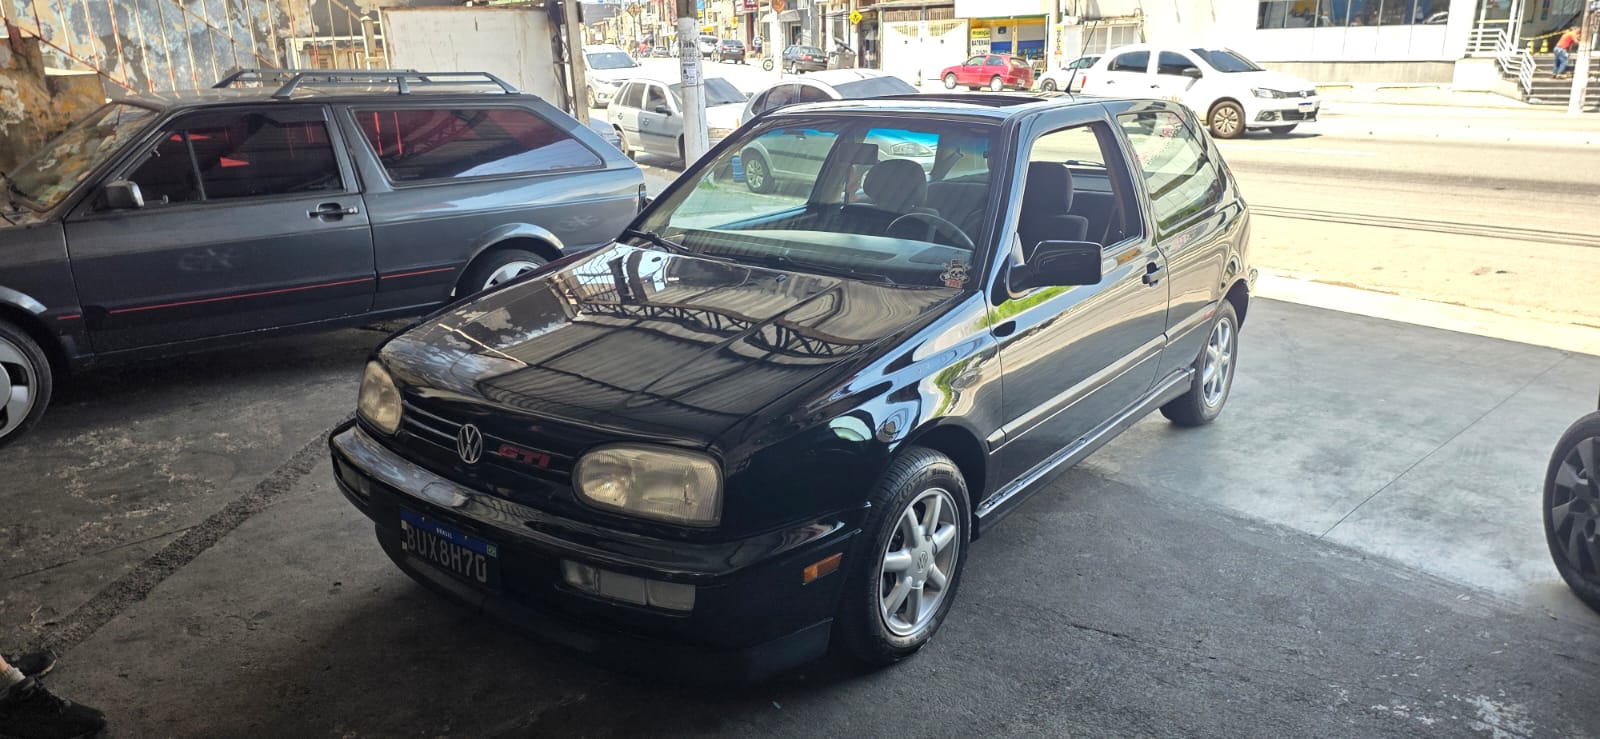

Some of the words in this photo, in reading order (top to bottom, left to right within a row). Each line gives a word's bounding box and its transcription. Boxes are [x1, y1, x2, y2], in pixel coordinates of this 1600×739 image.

[498, 444, 552, 469] GTI
[436, 528, 453, 540] BRASIL
[406, 524, 487, 583] BUX8H70
